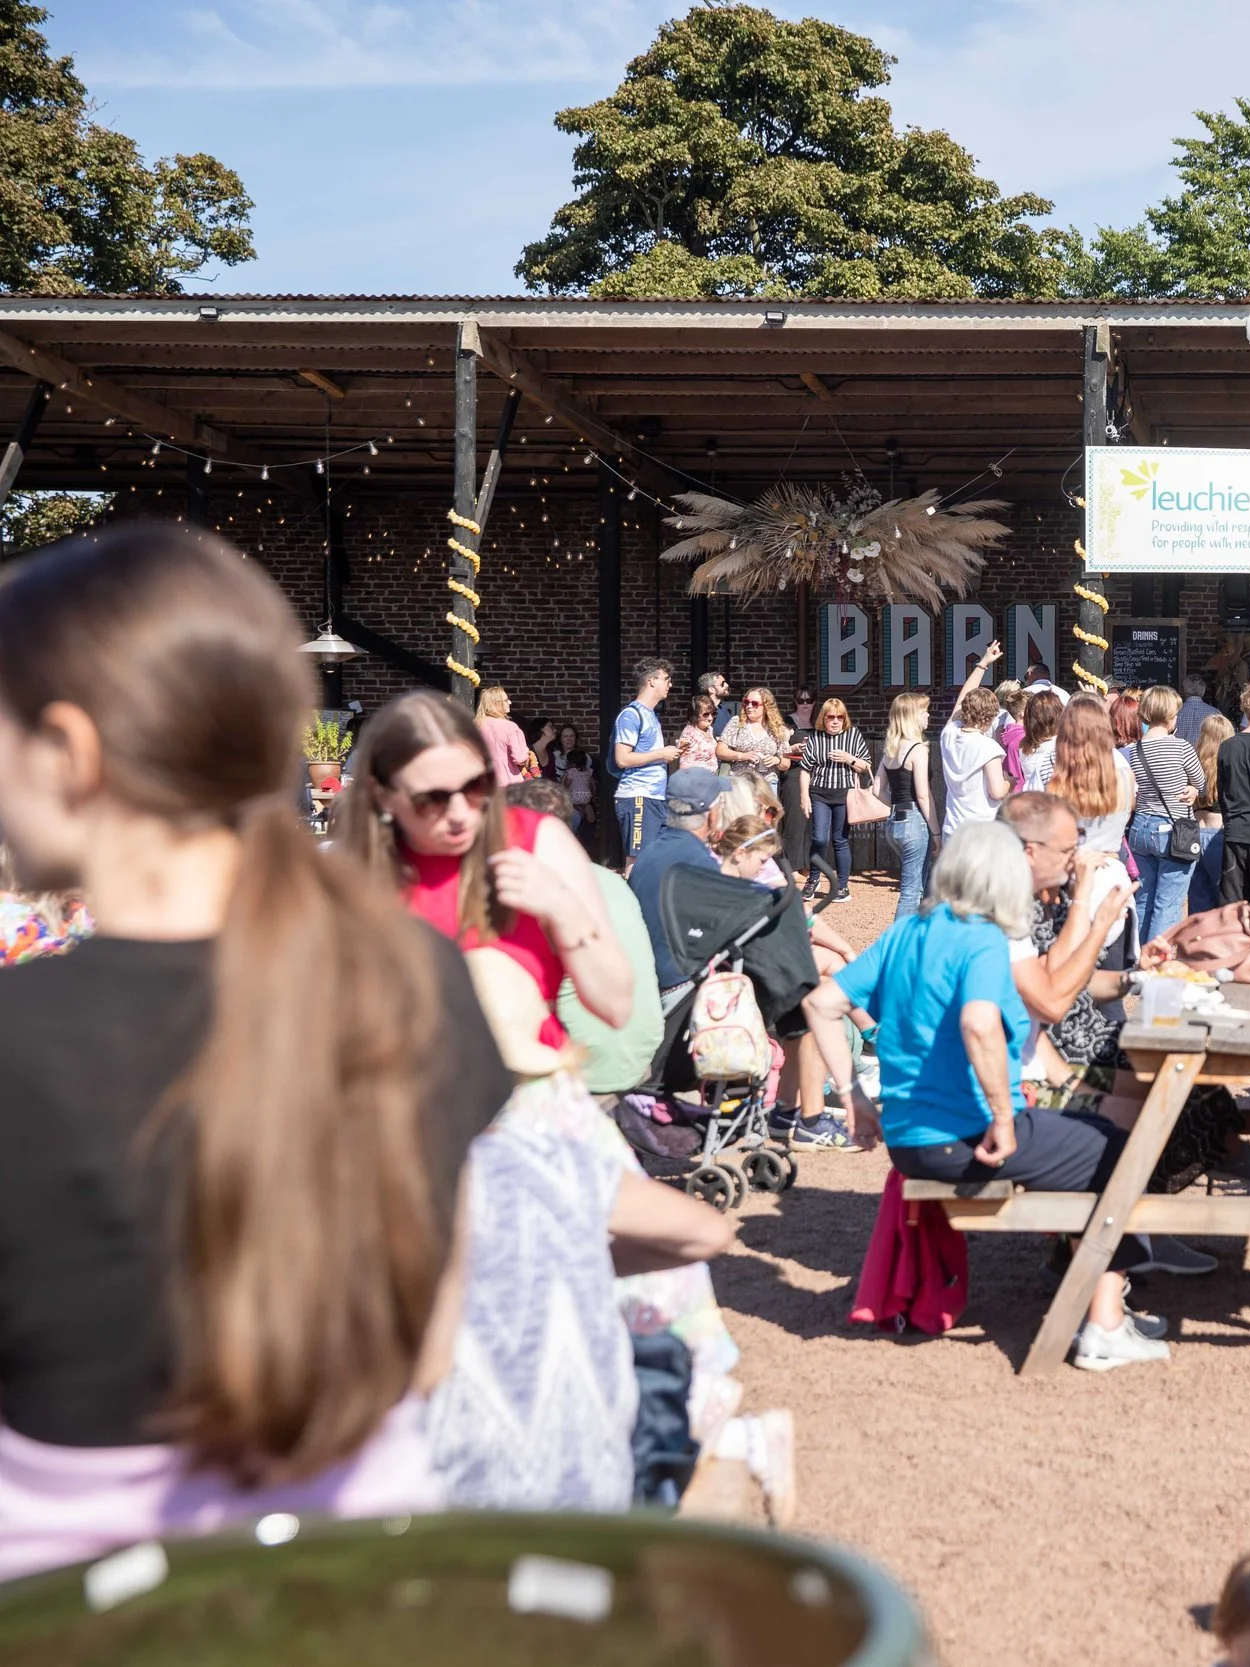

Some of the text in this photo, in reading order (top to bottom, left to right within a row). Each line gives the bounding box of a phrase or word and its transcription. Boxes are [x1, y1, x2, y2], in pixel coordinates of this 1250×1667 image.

[1152, 480, 1250, 512] leuchie
[1151, 519, 1203, 538] Providing
[1206, 519, 1229, 533] vital
[1152, 535, 1169, 549] for
[1172, 536, 1208, 554] people
[1209, 536, 1233, 550] with
[1132, 630, 1159, 641] DRINKS
[820, 603, 1056, 688] BARN
